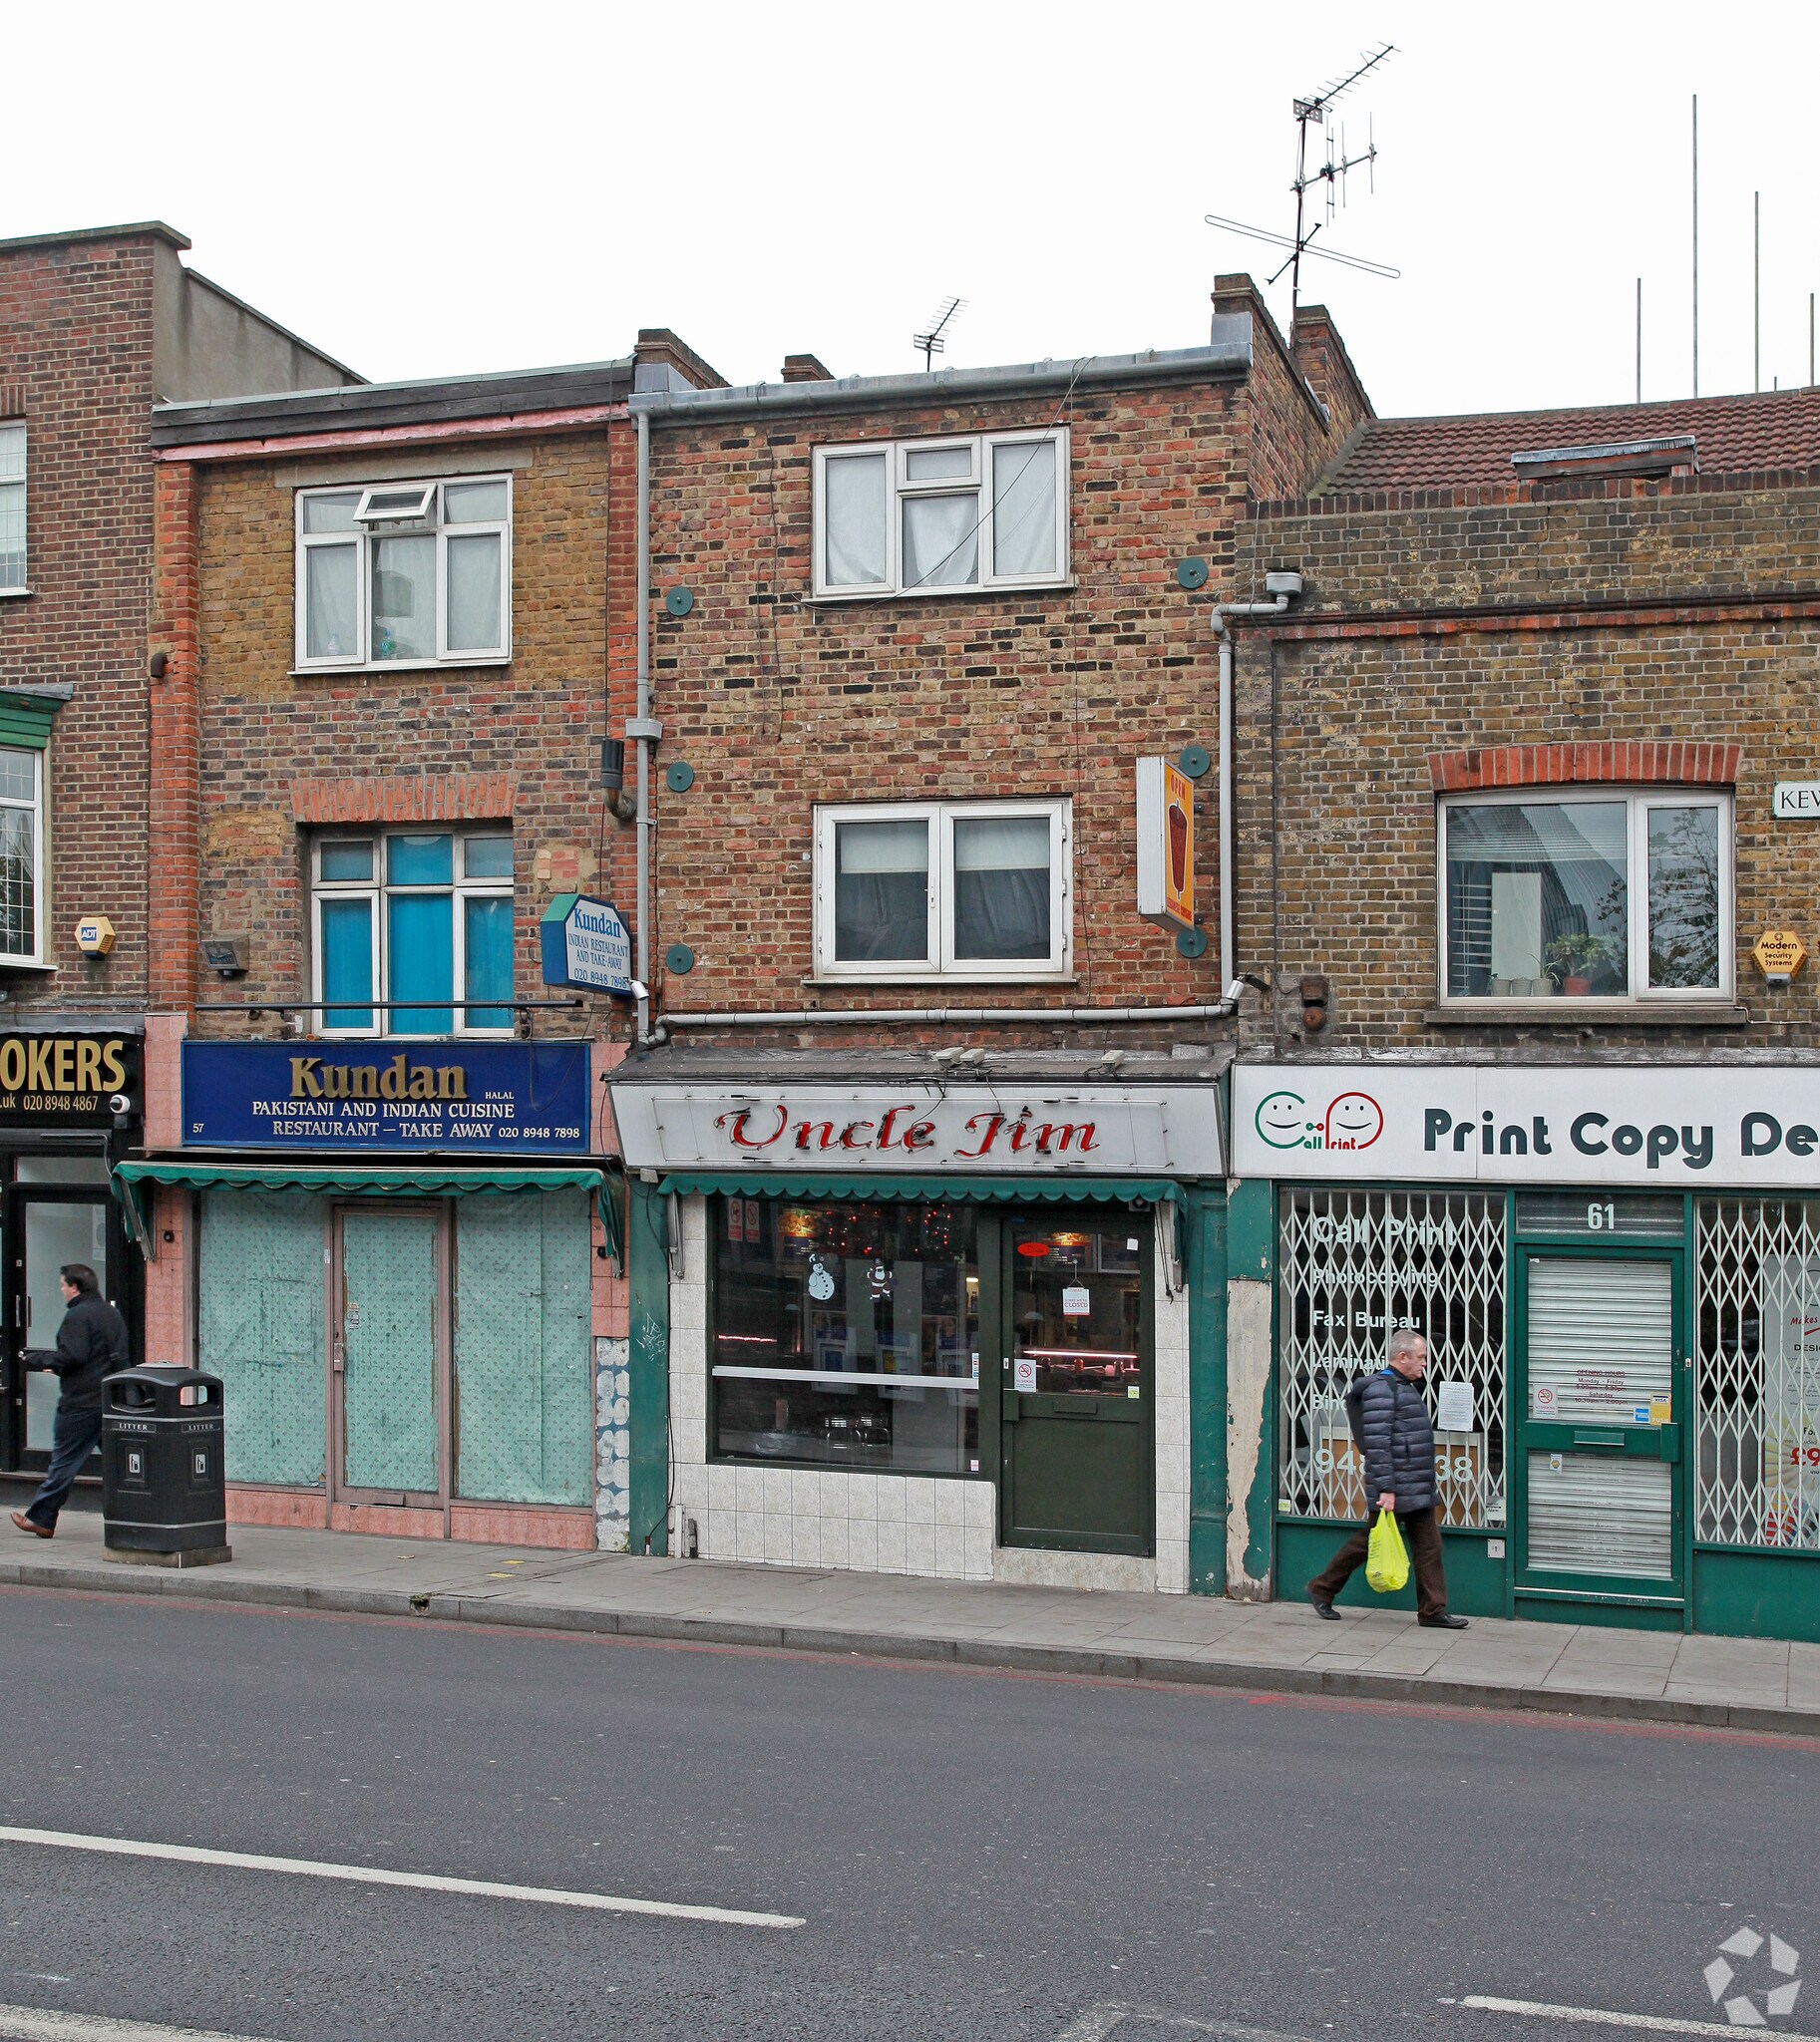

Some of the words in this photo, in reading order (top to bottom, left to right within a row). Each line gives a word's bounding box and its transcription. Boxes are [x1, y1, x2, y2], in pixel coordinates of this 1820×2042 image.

[1171, 774, 1186, 801] OPEN
[574, 907, 621, 938] Kundan
[82, 927, 97, 939] ADT
[568, 933, 589, 949] INDIAN
[591, 938, 628, 957] RESTAURANT
[1761, 941, 1797, 950] Modern
[576, 949, 589, 962] AND
[1764, 951, 1793, 960] Security
[574, 968, 587, 981] 020
[590, 971, 608, 985] 8948
[610, 975, 627, 988] 7898
[0, 1039, 126, 1092] OKERS
[288, 1053, 469, 1100] Kundan
[23, 1095, 42, 1111] 020
[45, 1095, 70, 1111] 8948
[73, 1095, 99, 1111] 4867
[485, 1091, 515, 1100] HALAL
[252, 1101, 333, 1117] PAKISTANI
[340, 1103, 377, 1117] AND
[383, 1103, 442, 1118] INDIAN
[449, 1104, 516, 1119] CUISINE
[192, 1123, 205, 1134] 57
[272, 1121, 380, 1137] RESTAURANT
[399, 1123, 443, 1138] TAKE
[449, 1124, 495, 1138] AWAY
[499, 1127, 519, 1138] 020
[523, 1128, 550, 1139] 8948
[554, 1128, 580, 1139] 7898
[714, 1104, 935, 1151] Uncle
[953, 1106, 1100, 1161] Jim
[1424, 1108, 1553, 1155] Print
[1570, 1112, 1713, 1170] Copy
[1740, 1112, 1820, 1157] De
[1587, 1202, 1615, 1229] 61
[1312, 1216, 1368, 1243] Call
[1385, 1219, 1457, 1246] Print
[1312, 1268, 1438, 1287] Photocopying
[1312, 1310, 1346, 1327] Fax
[1354, 1311, 1420, 1329] Bureau
[1312, 1352, 1386, 1370] Laminati
[1435, 1455, 1473, 1483] 38
